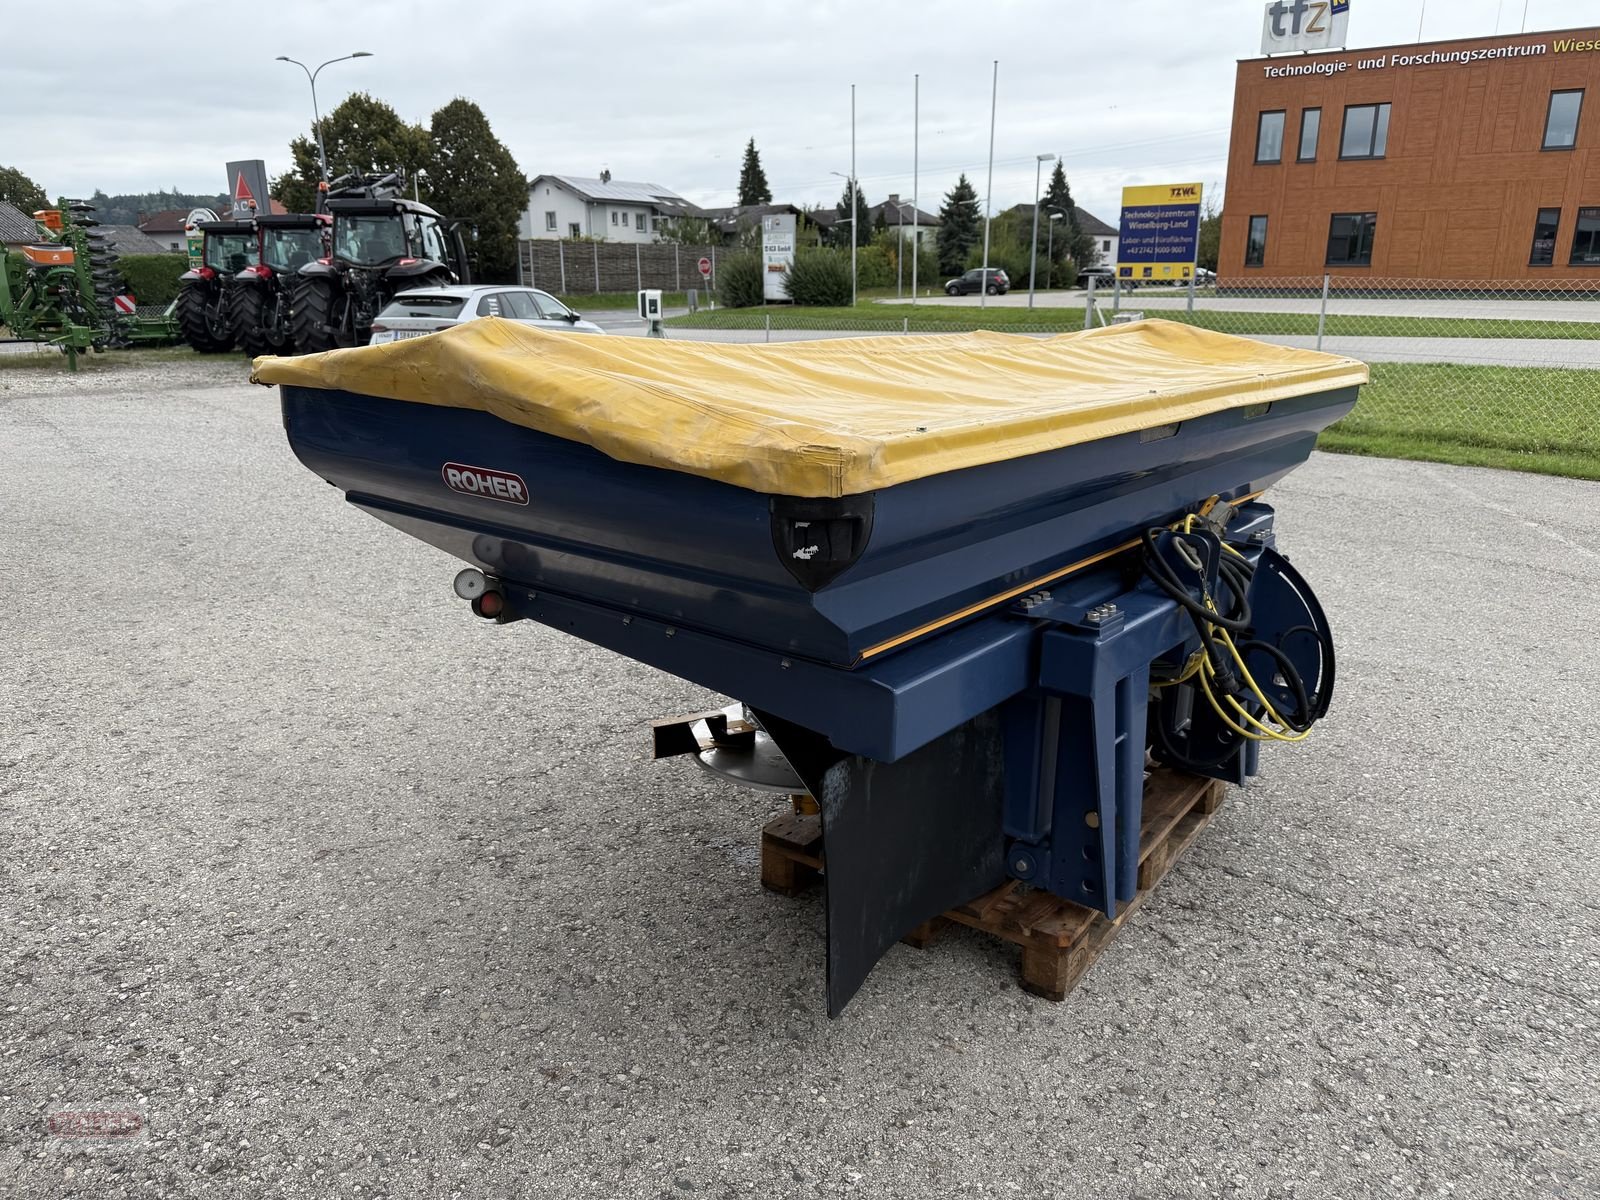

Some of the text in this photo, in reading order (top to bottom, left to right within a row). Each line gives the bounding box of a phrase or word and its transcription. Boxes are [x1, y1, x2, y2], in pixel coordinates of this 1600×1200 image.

[1269, 0, 1329, 37] tfz
[1263, 60, 1352, 78] Technologie-
[1357, 55, 1386, 70] und
[1390, 43, 1546, 67] Forschungszentrum
[1128, 219, 1189, 230] Wieselburg-Land
[446, 467, 525, 502] ROHER
